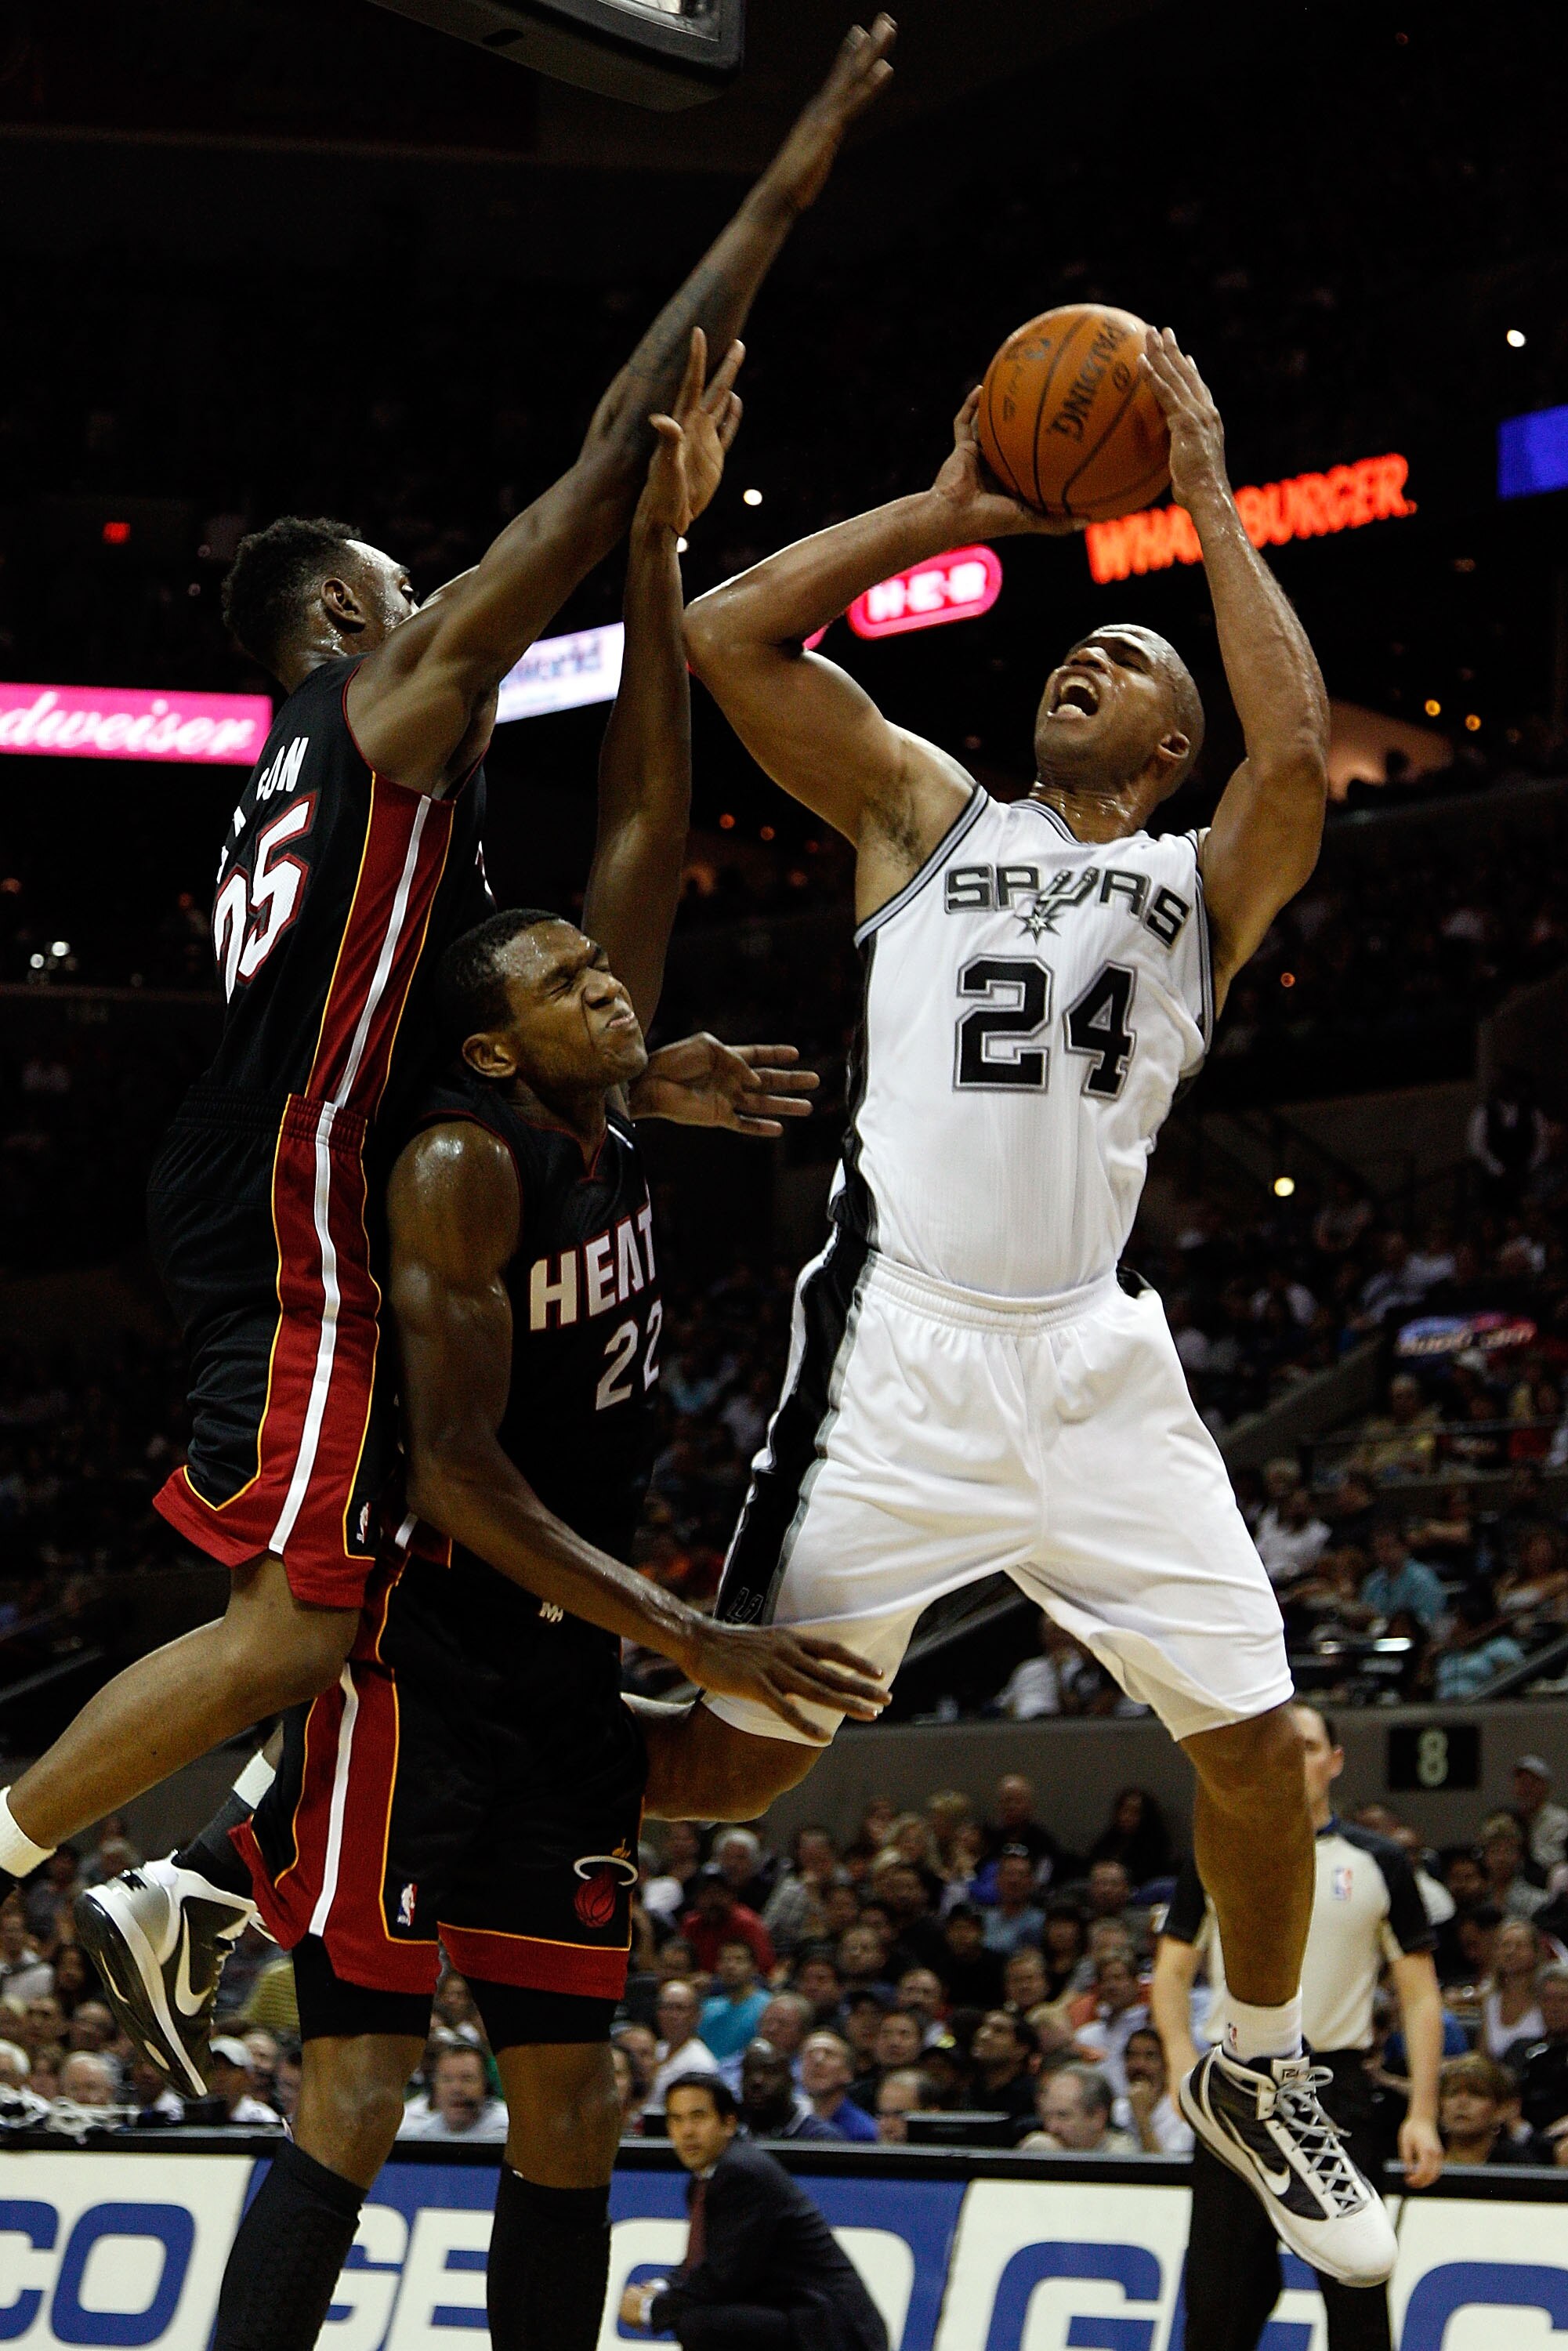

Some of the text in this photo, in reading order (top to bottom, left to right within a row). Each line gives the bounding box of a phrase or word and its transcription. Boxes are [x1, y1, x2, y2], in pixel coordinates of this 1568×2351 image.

[1086, 454, 1409, 584] WHABURGER
[945, 864, 1193, 950] SPURS
[953, 953, 1137, 1101] 24
[530, 1204, 657, 1331] HEAT
[595, 1298, 663, 1411] 22
[1416, 1730, 1448, 1787] 8
